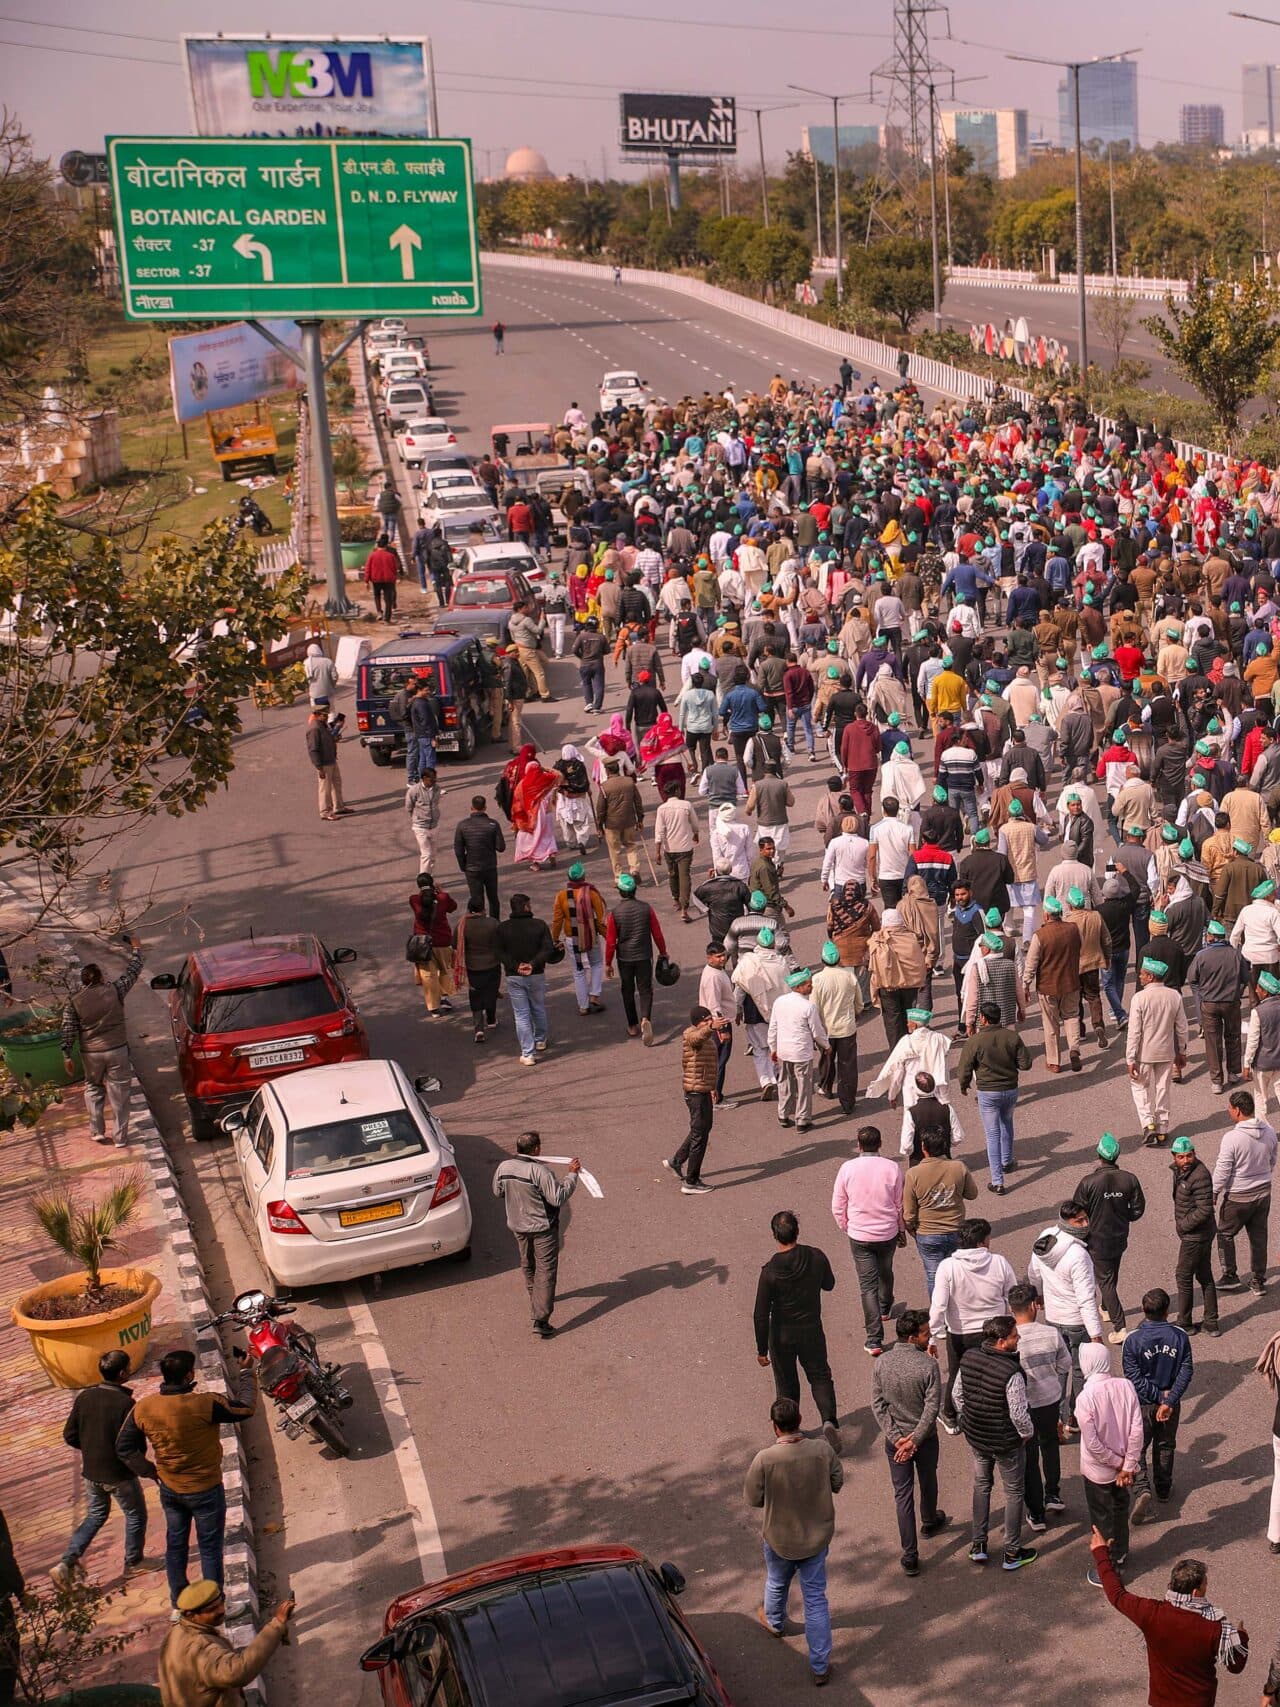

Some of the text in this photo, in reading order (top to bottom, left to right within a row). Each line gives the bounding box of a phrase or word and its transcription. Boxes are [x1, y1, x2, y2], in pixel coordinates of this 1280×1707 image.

[246, 48, 374, 98] M3M
[627, 116, 733, 143] BHUTANI
[124, 158, 247, 188] बोटानिकल
[258, 158, 321, 188] गार्डन
[351, 190, 458, 203] D. N. D. FLYWAY
[130, 209, 327, 225] BOTANICAL GARDEN
[136, 267, 181, 278] SECTOR
[118, 1312, 151, 1346] noid
